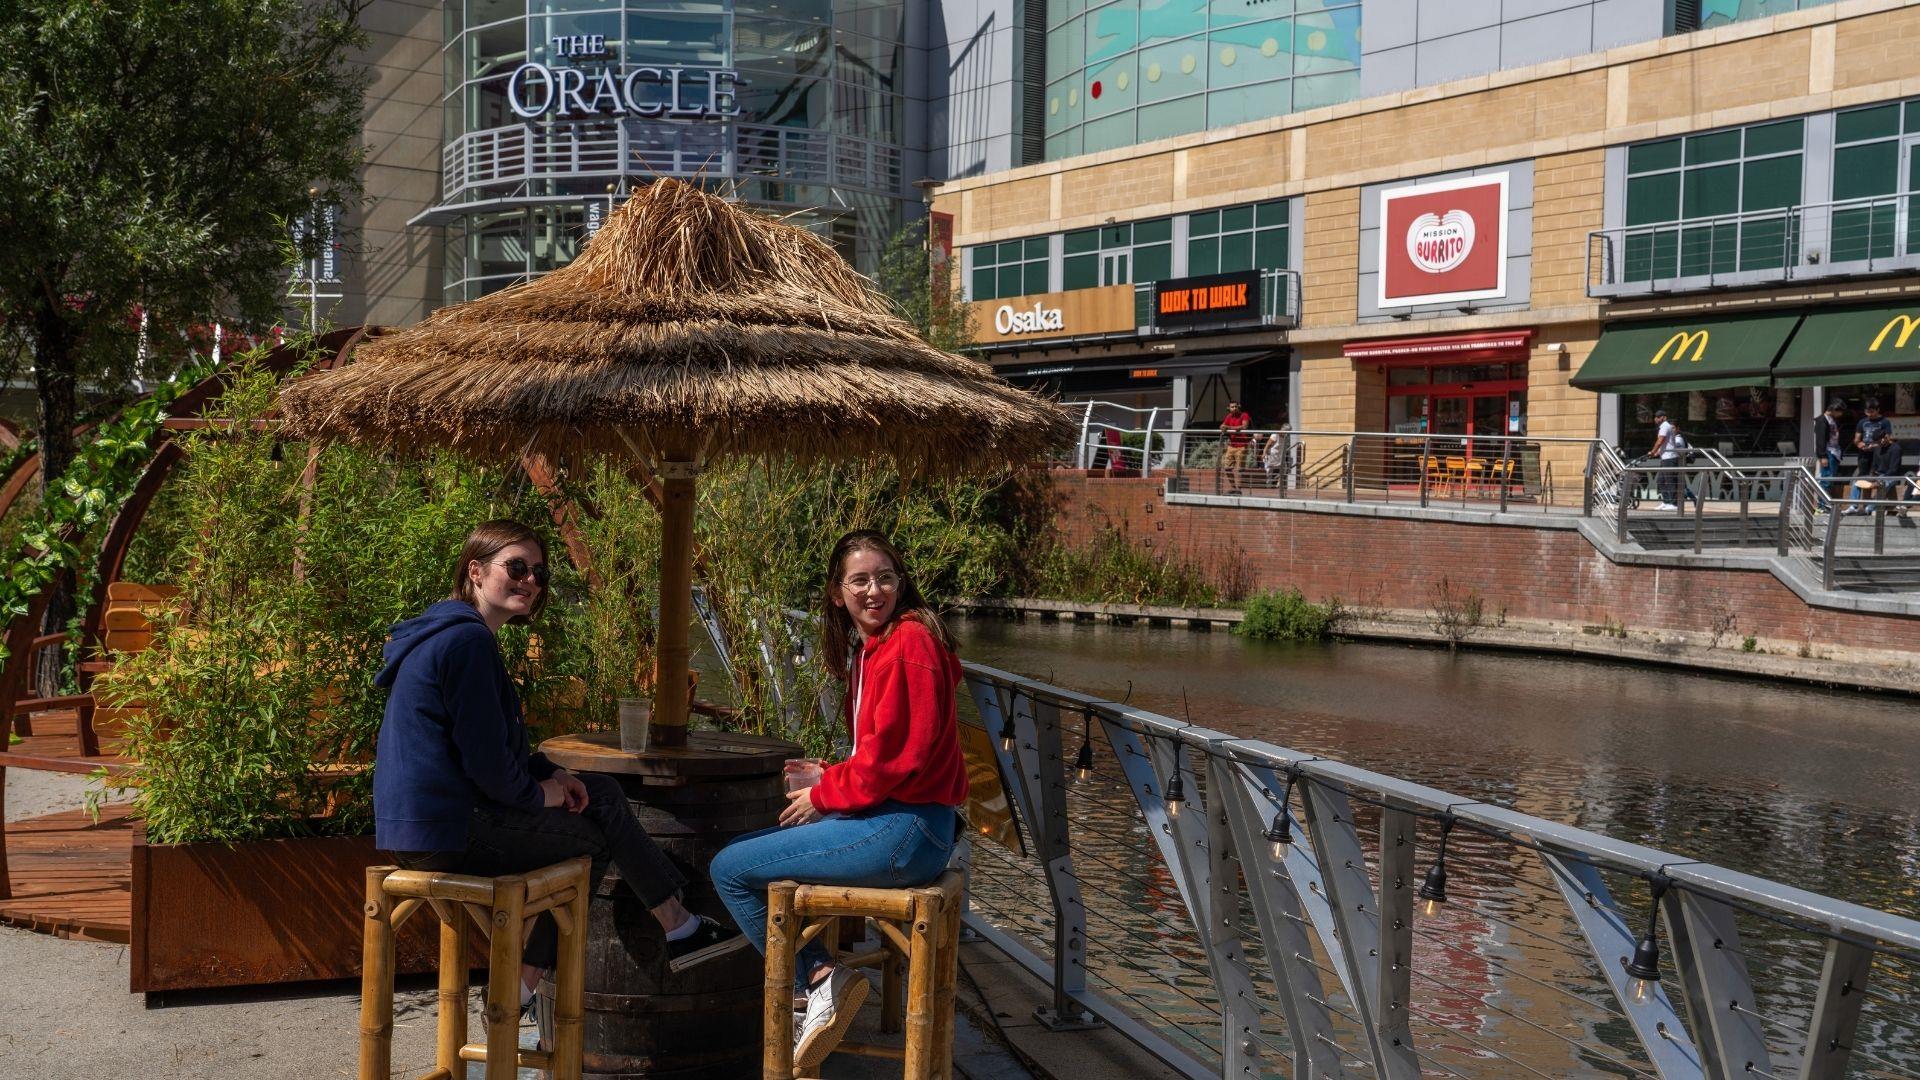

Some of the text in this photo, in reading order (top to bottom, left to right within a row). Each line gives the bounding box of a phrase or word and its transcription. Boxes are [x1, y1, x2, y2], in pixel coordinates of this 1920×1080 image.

[552, 35, 605, 57] THE
[508, 62, 741, 118] ORACLE
[1423, 229, 1457, 238] MISSION
[1417, 237, 1463, 263] BURRITO
[1161, 283, 1247, 313] WOK TO WALK
[995, 301, 1064, 335] Osaka
